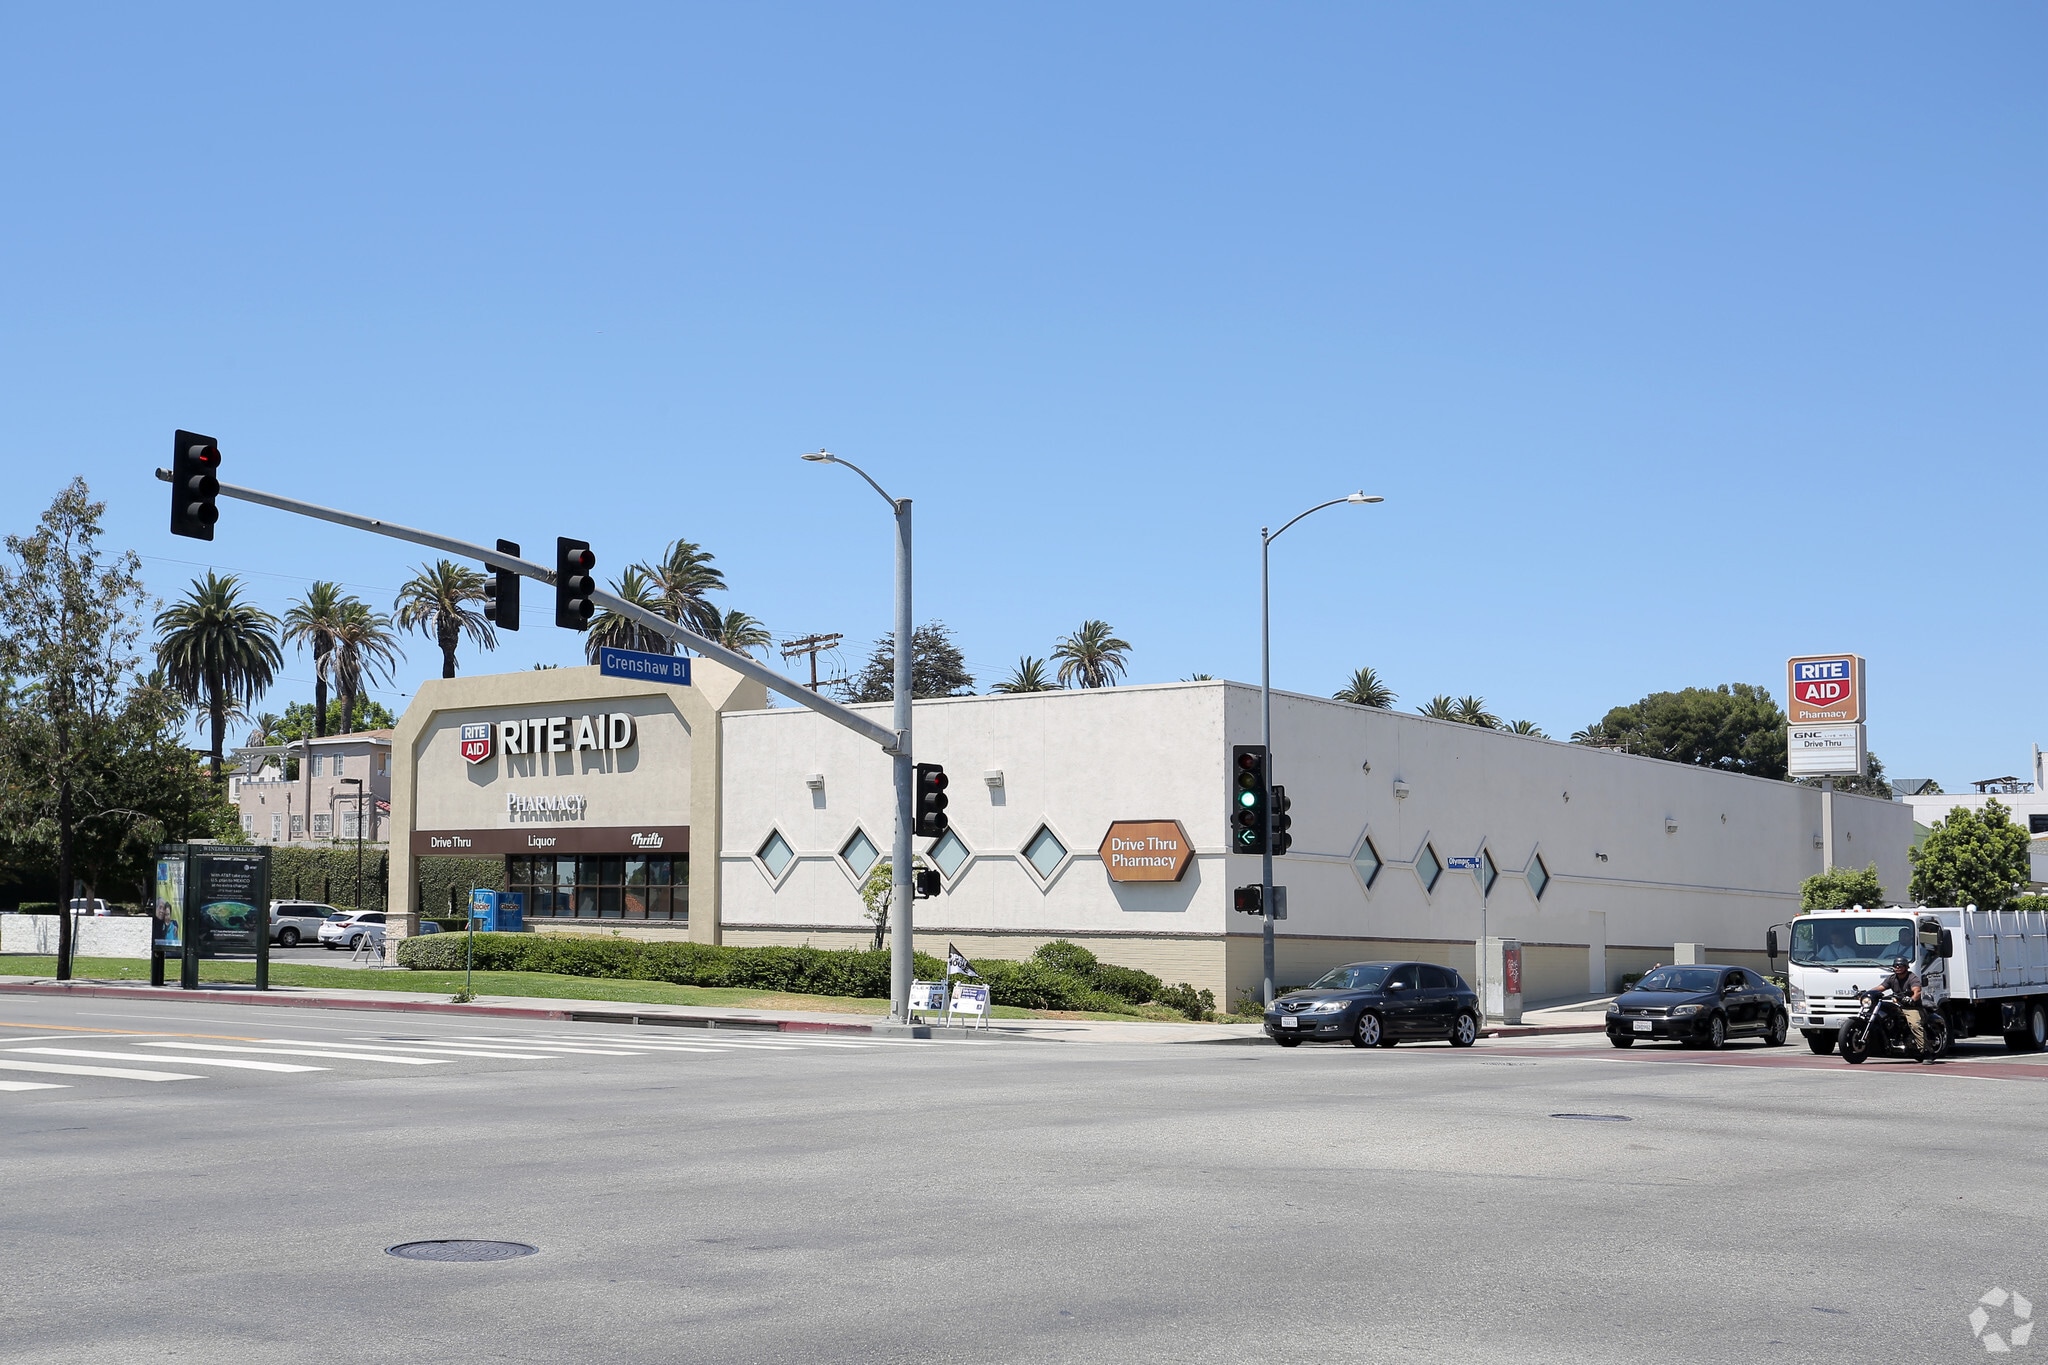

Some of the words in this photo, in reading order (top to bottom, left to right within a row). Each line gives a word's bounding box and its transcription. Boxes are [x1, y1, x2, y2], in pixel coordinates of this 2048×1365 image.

[606, 653, 669, 675] Crenshaw
[672, 661, 686, 678] Bl
[1801, 662, 1843, 679] RITE
[1805, 683, 1841, 700] AID
[1799, 710, 1847, 719] Pharmacy
[464, 725, 486, 739] RITE
[500, 716, 567, 755] RITE
[574, 712, 632, 750] AID
[1794, 731, 1822, 739] GNC
[465, 742, 484, 756] AID
[1804, 740, 1823, 748] Drive
[1824, 739, 1842, 747] Thru
[431, 836, 452, 848] Drive
[452, 837, 472, 848] Thru
[528, 835, 556, 849] Liquor
[630, 832, 664, 848] Thrifty
[1111, 837, 1145, 851] Drive
[1146, 837, 1177, 850] Thru
[1112, 853, 1176, 870] Pharmacy
[1449, 857, 1470, 866] Olympic
